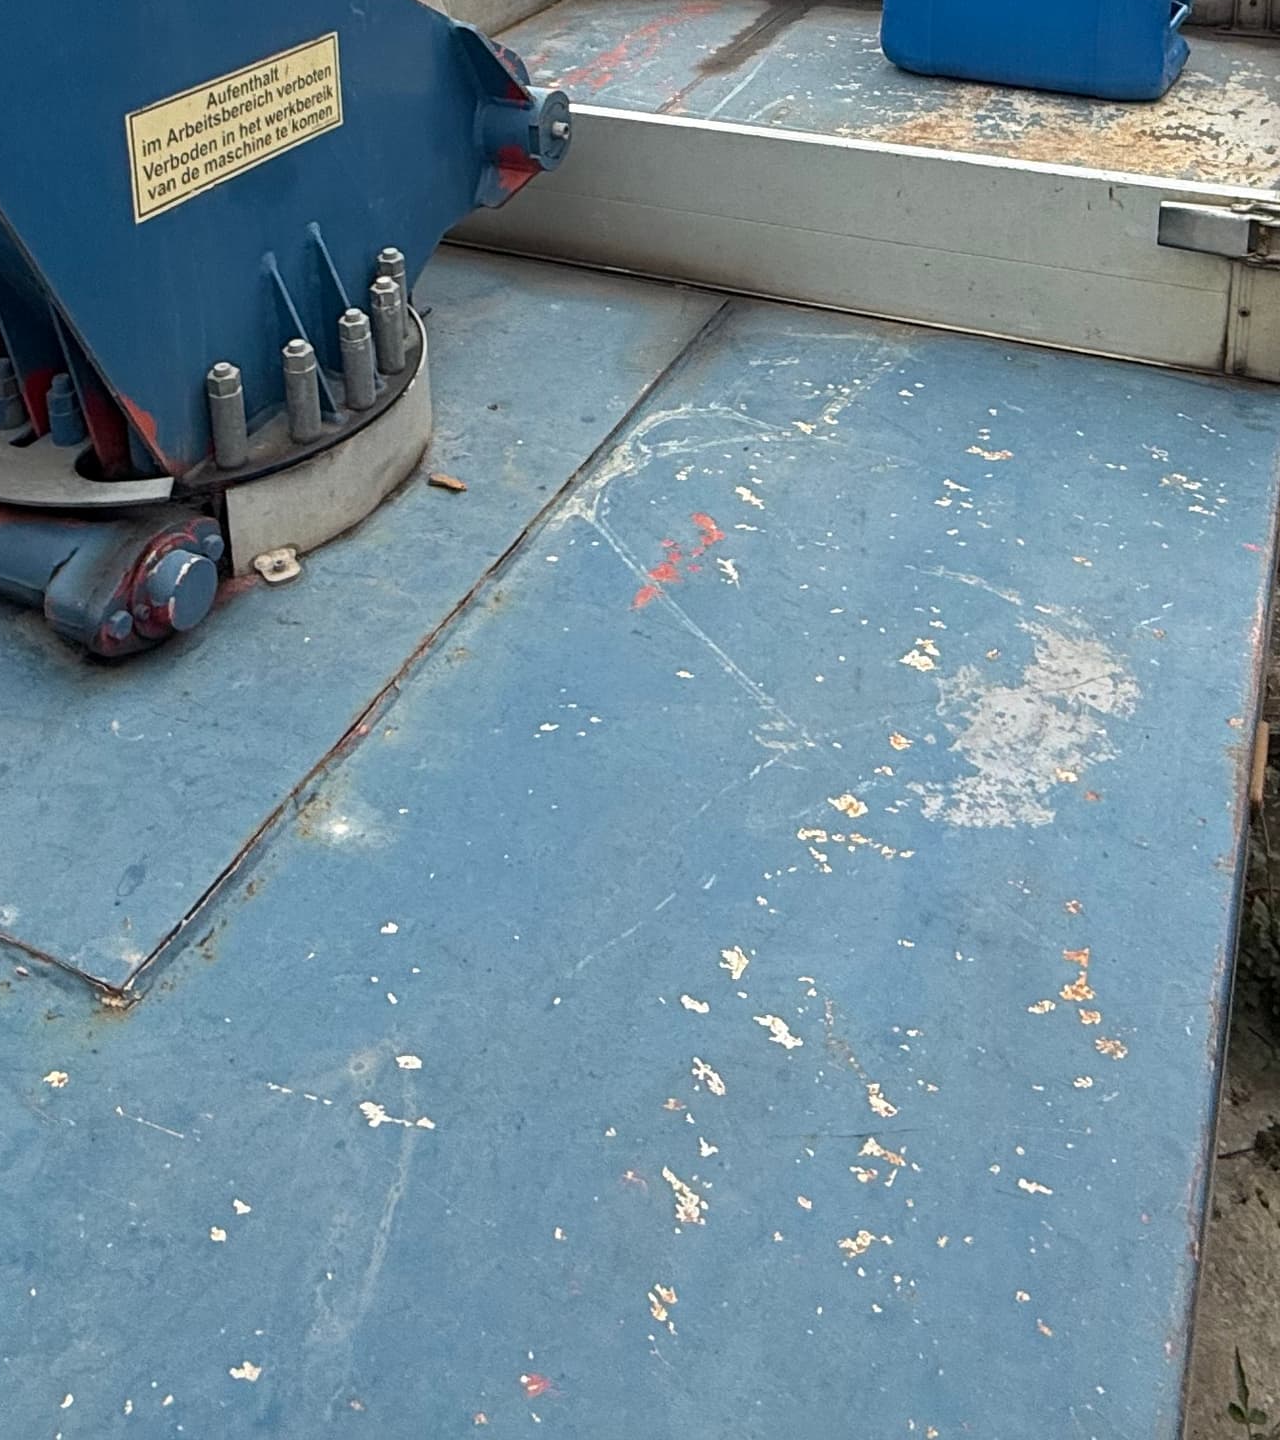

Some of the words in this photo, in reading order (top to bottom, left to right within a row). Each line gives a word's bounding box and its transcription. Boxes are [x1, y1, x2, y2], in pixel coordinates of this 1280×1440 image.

[141, 136, 162, 157] im
[167, 89, 273, 147] Arbeitsbereich
[278, 64, 332, 100] verboten
[206, 64, 279, 109] Aufenthalt
[143, 137, 218, 181] Verboden
[222, 129, 236, 148] in
[239, 119, 262, 140] het
[265, 85, 334, 128] werkbereik
[181, 164, 200, 183] de
[204, 134, 272, 176] maschine
[275, 123, 288, 141] te
[292, 103, 333, 133] komen
